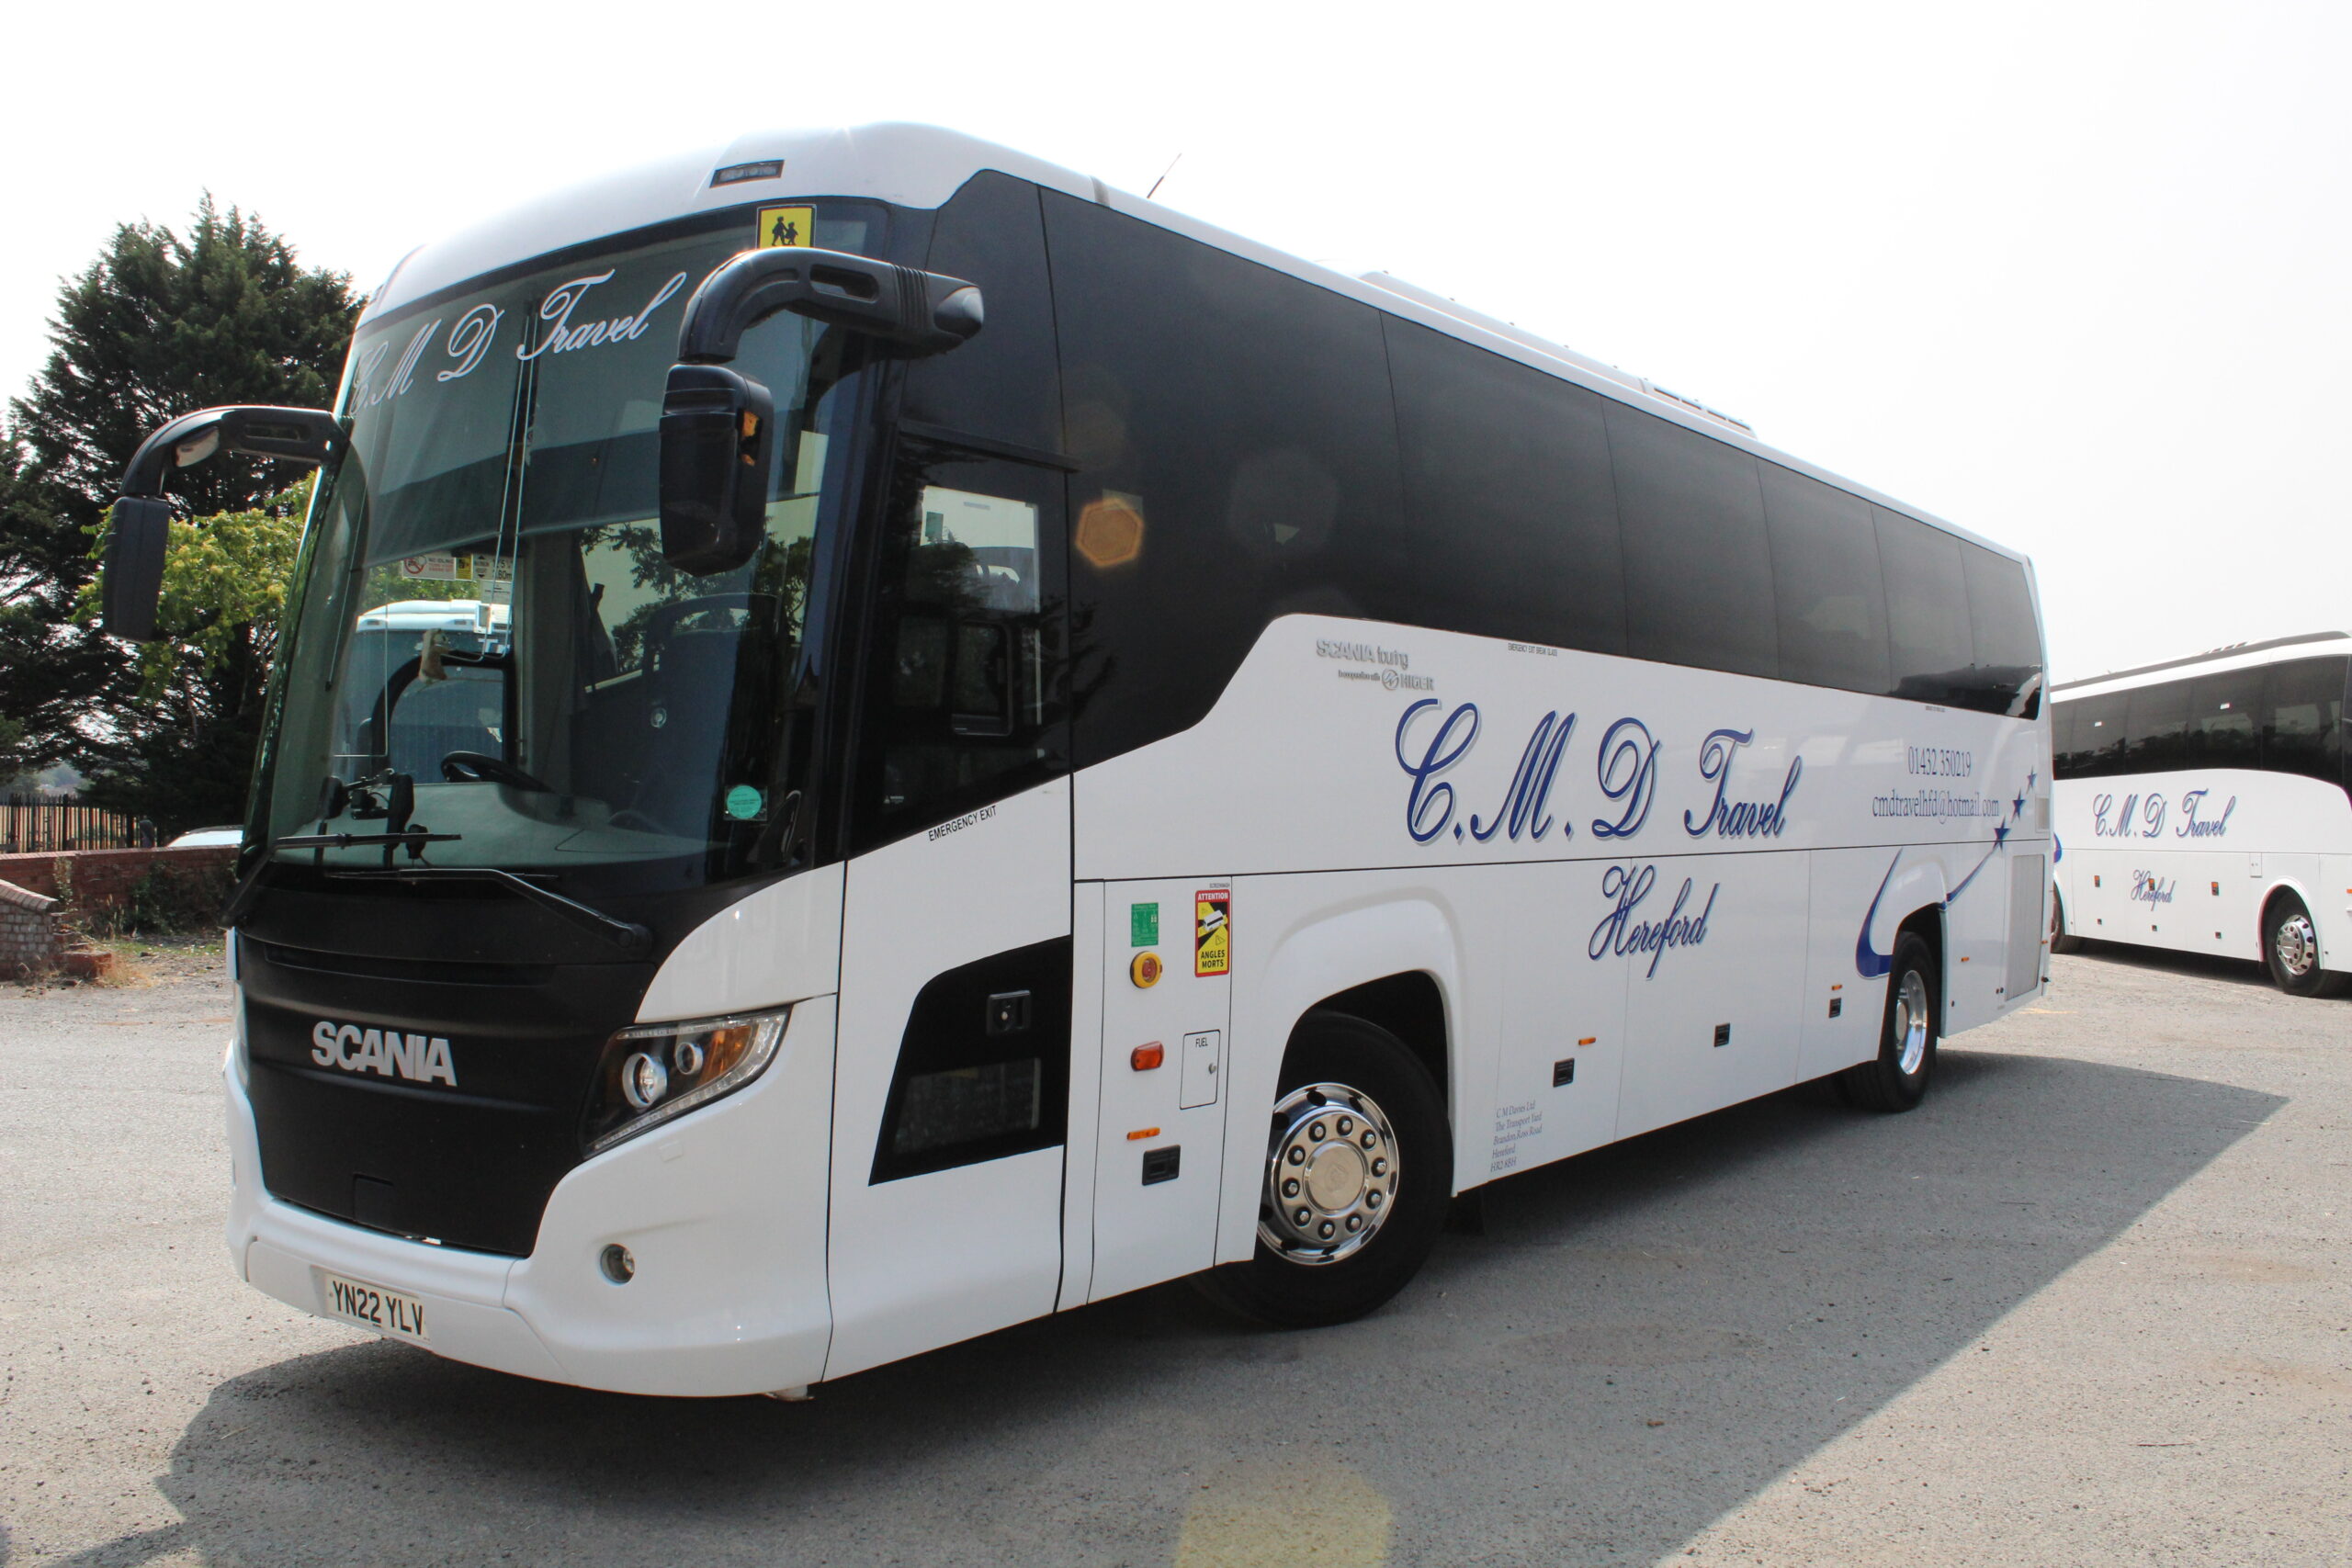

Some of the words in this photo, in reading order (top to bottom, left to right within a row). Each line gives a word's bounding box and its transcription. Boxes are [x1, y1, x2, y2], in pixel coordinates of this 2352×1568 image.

[516, 268, 686, 360] Travel
[1316, 638, 1375, 662] SCANIA
[1908, 746, 1937, 775] 01432
[1939, 749, 1972, 778] 350219
[1684, 728, 1803, 837] Travel
[928, 813, 978, 841] EMERGENCY
[979, 805, 997, 820] EXIT
[2176, 788, 2236, 838] Travel
[1198, 891, 1228, 901] ATTENTION
[2131, 869, 2177, 912] Hereford
[1589, 865, 1720, 980] Hereford
[1200, 949, 1225, 960] ANGLES
[1202, 958, 1224, 969] MORTS
[311, 1021, 458, 1087] SCANIA
[1195, 1037, 1208, 1048] FUEL
[332, 1280, 381, 1324] YN22
[386, 1295, 423, 1336] YLV
